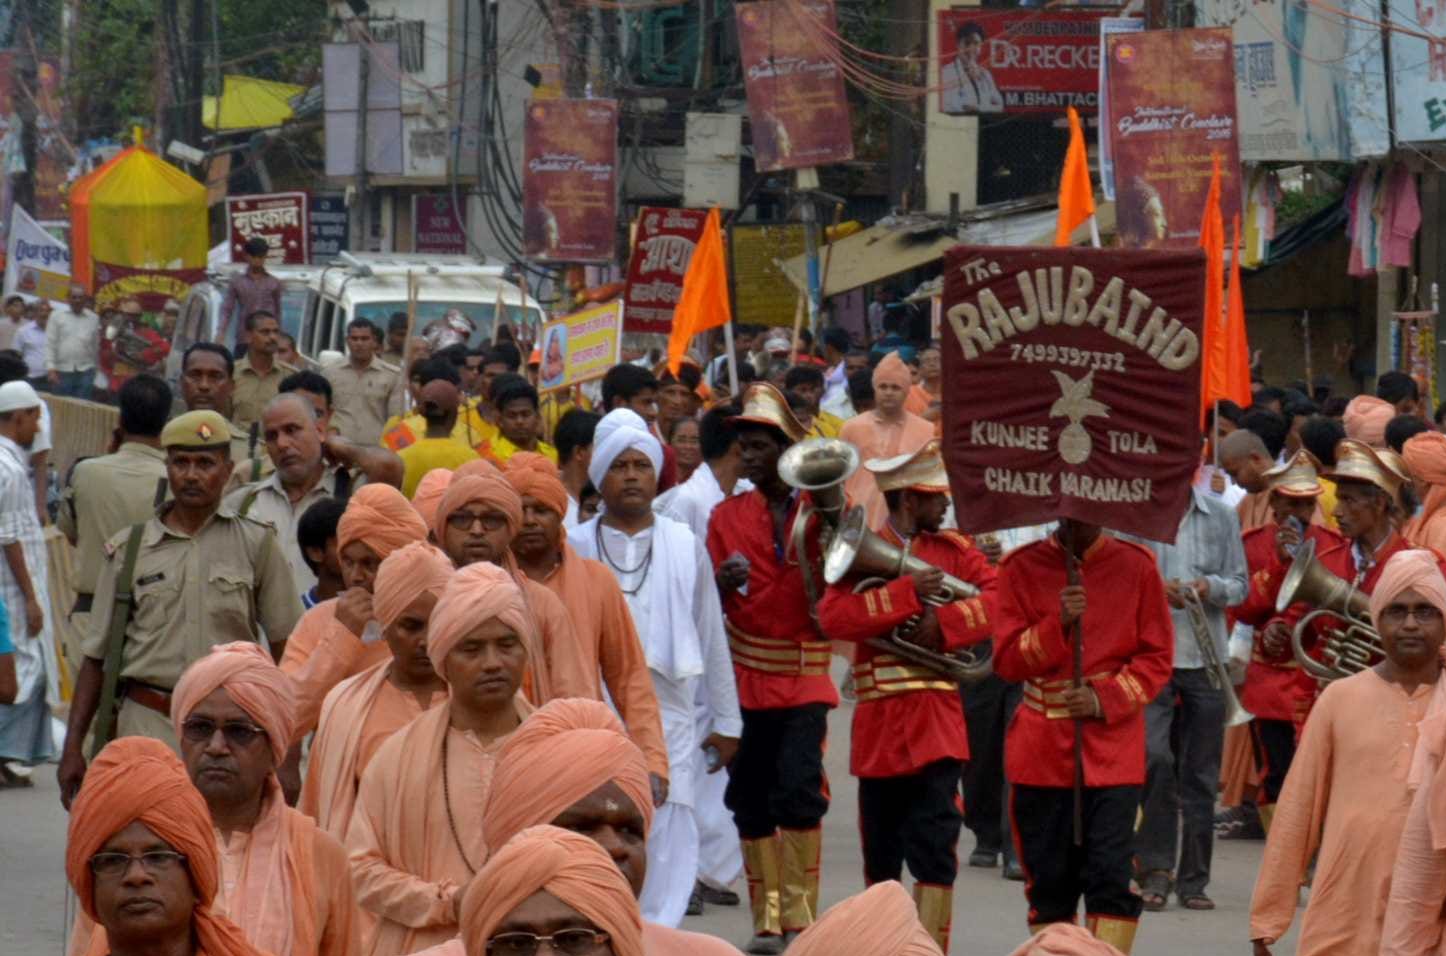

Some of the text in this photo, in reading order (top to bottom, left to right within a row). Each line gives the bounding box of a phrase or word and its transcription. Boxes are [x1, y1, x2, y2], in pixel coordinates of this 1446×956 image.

[960, 258, 1002, 286] The
[971, 421, 1158, 453] KUNJEE TOLA
[1060, 471, 1152, 502] VARANASI
